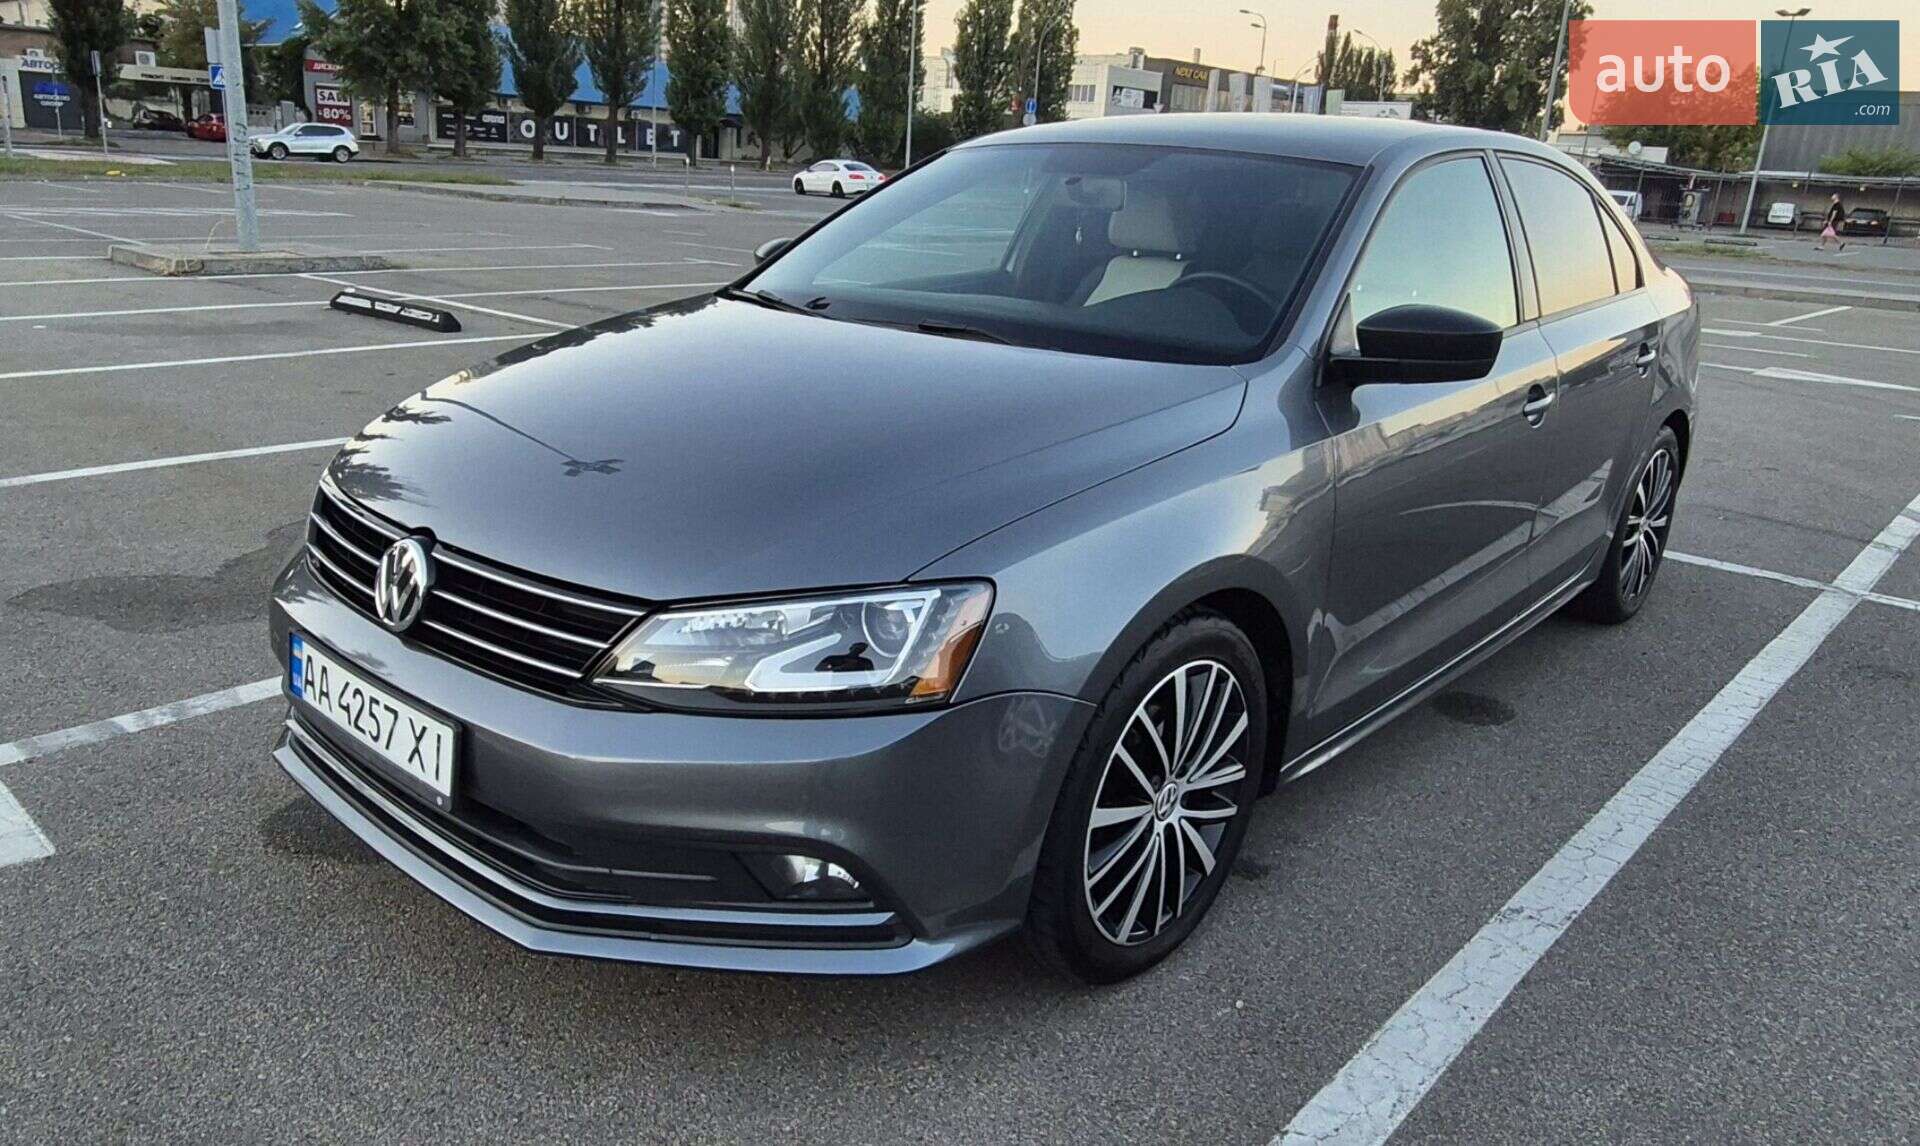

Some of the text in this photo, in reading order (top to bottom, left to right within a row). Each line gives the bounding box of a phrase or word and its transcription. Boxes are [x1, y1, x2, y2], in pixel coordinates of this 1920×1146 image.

[520, 119, 680, 148] OUTLET
[303, 655, 333, 713] AA
[338, 681, 399, 750] 4257
